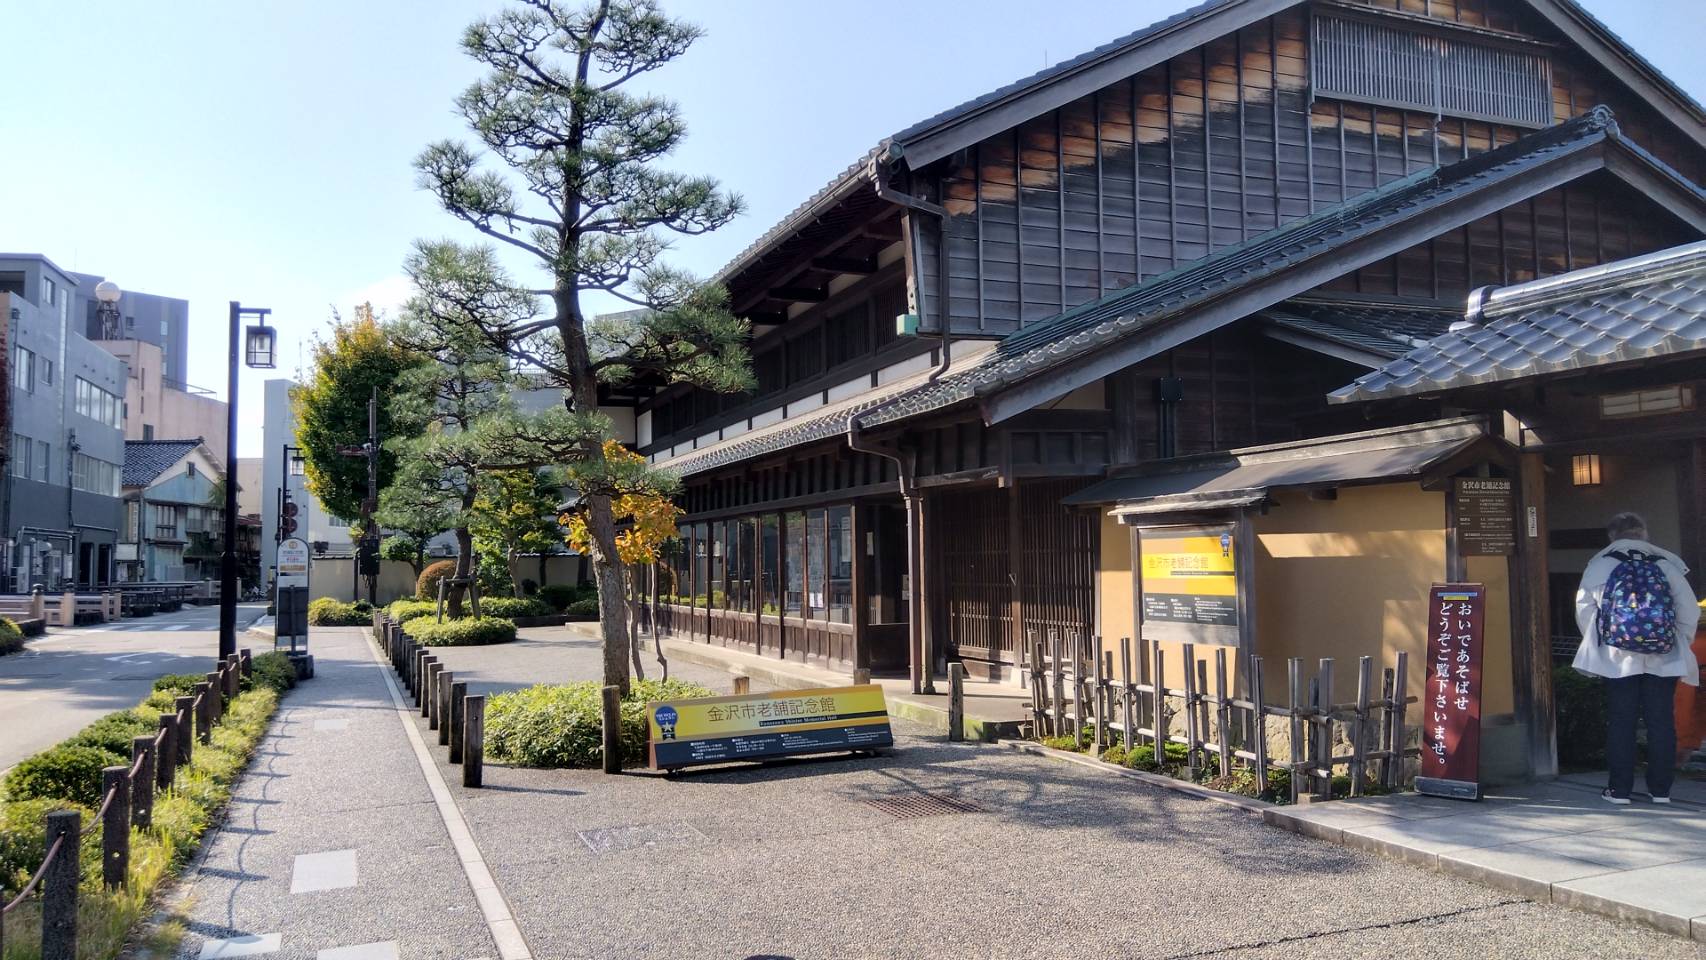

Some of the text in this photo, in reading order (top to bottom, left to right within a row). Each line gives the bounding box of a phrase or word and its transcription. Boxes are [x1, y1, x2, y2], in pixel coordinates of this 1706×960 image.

[707, 697, 836, 721] 金沢市老舗記念館
[1431, 602, 1453, 766] どうぞご覧下さいませ。
[1454, 603, 1472, 711] おいであそばせ
